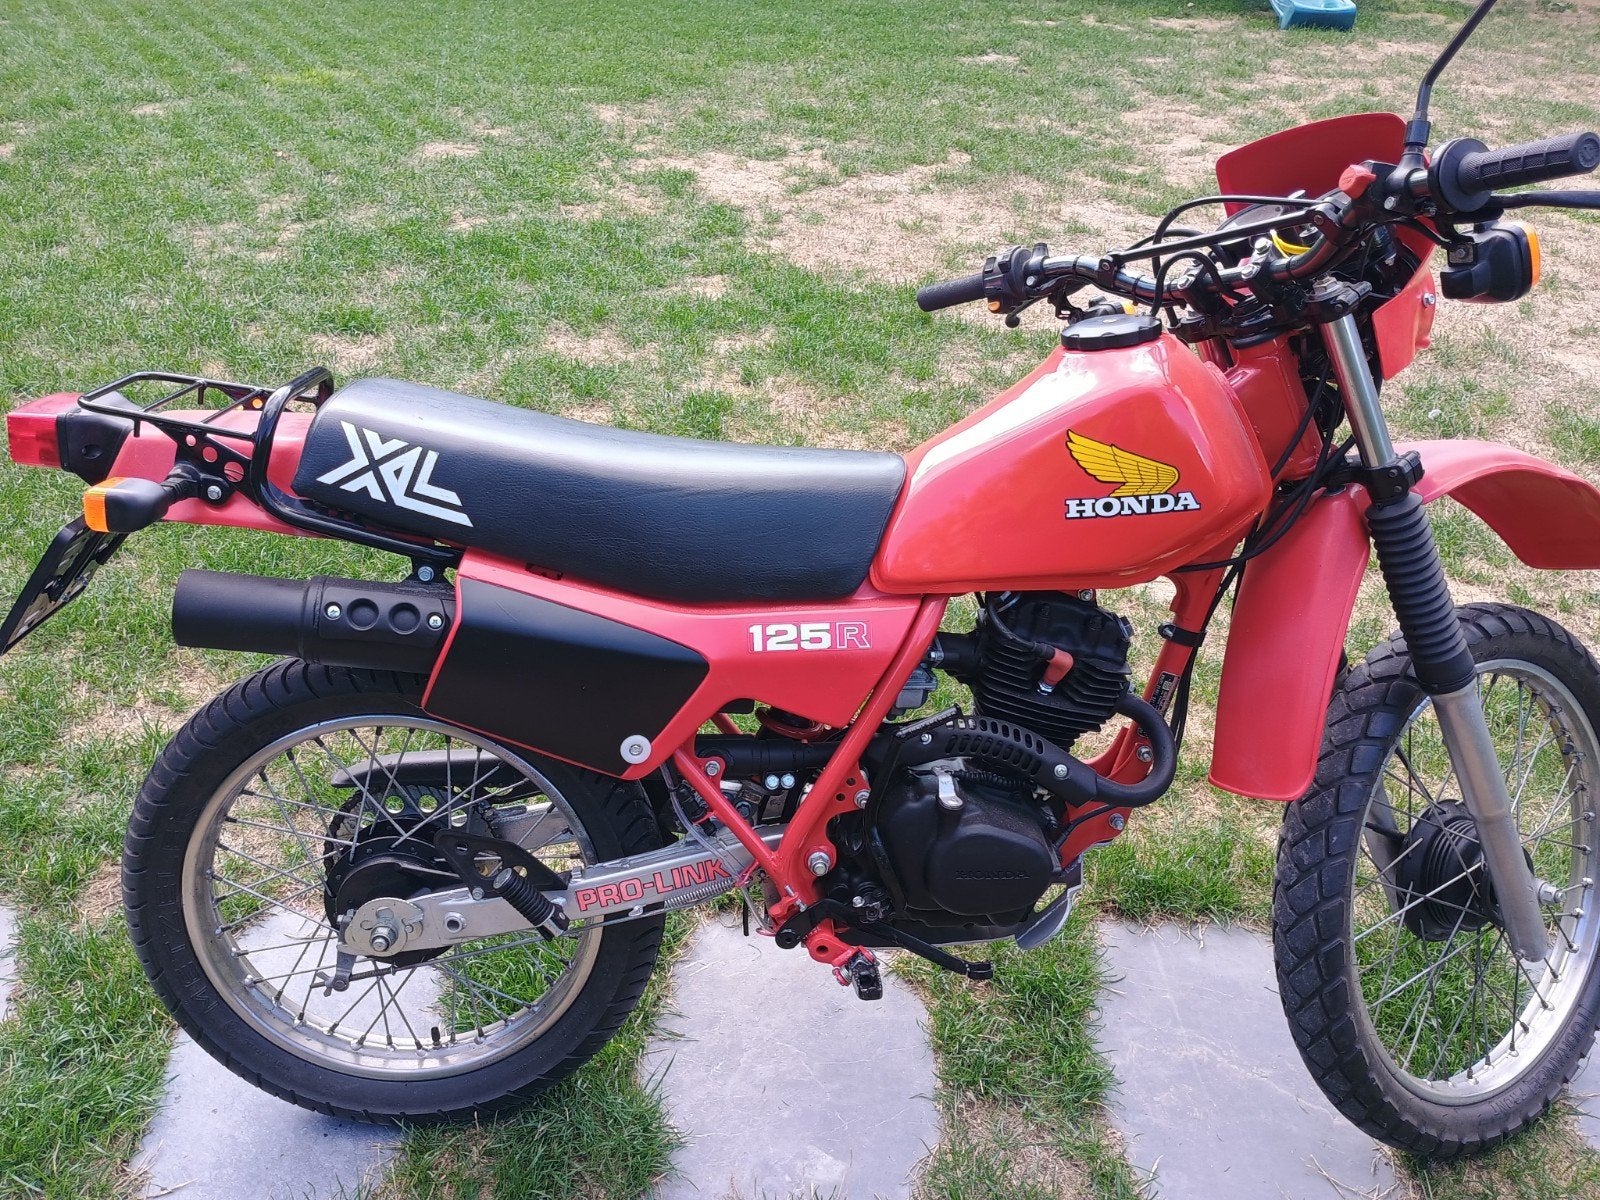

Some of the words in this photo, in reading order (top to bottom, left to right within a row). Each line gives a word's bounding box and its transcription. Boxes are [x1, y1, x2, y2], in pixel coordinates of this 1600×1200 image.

[316, 420, 474, 527] XL
[1065, 492, 1200, 520] HONDA
[575, 858, 731, 912] PRO-LINK
[955, 870, 1031, 881] HONDA
